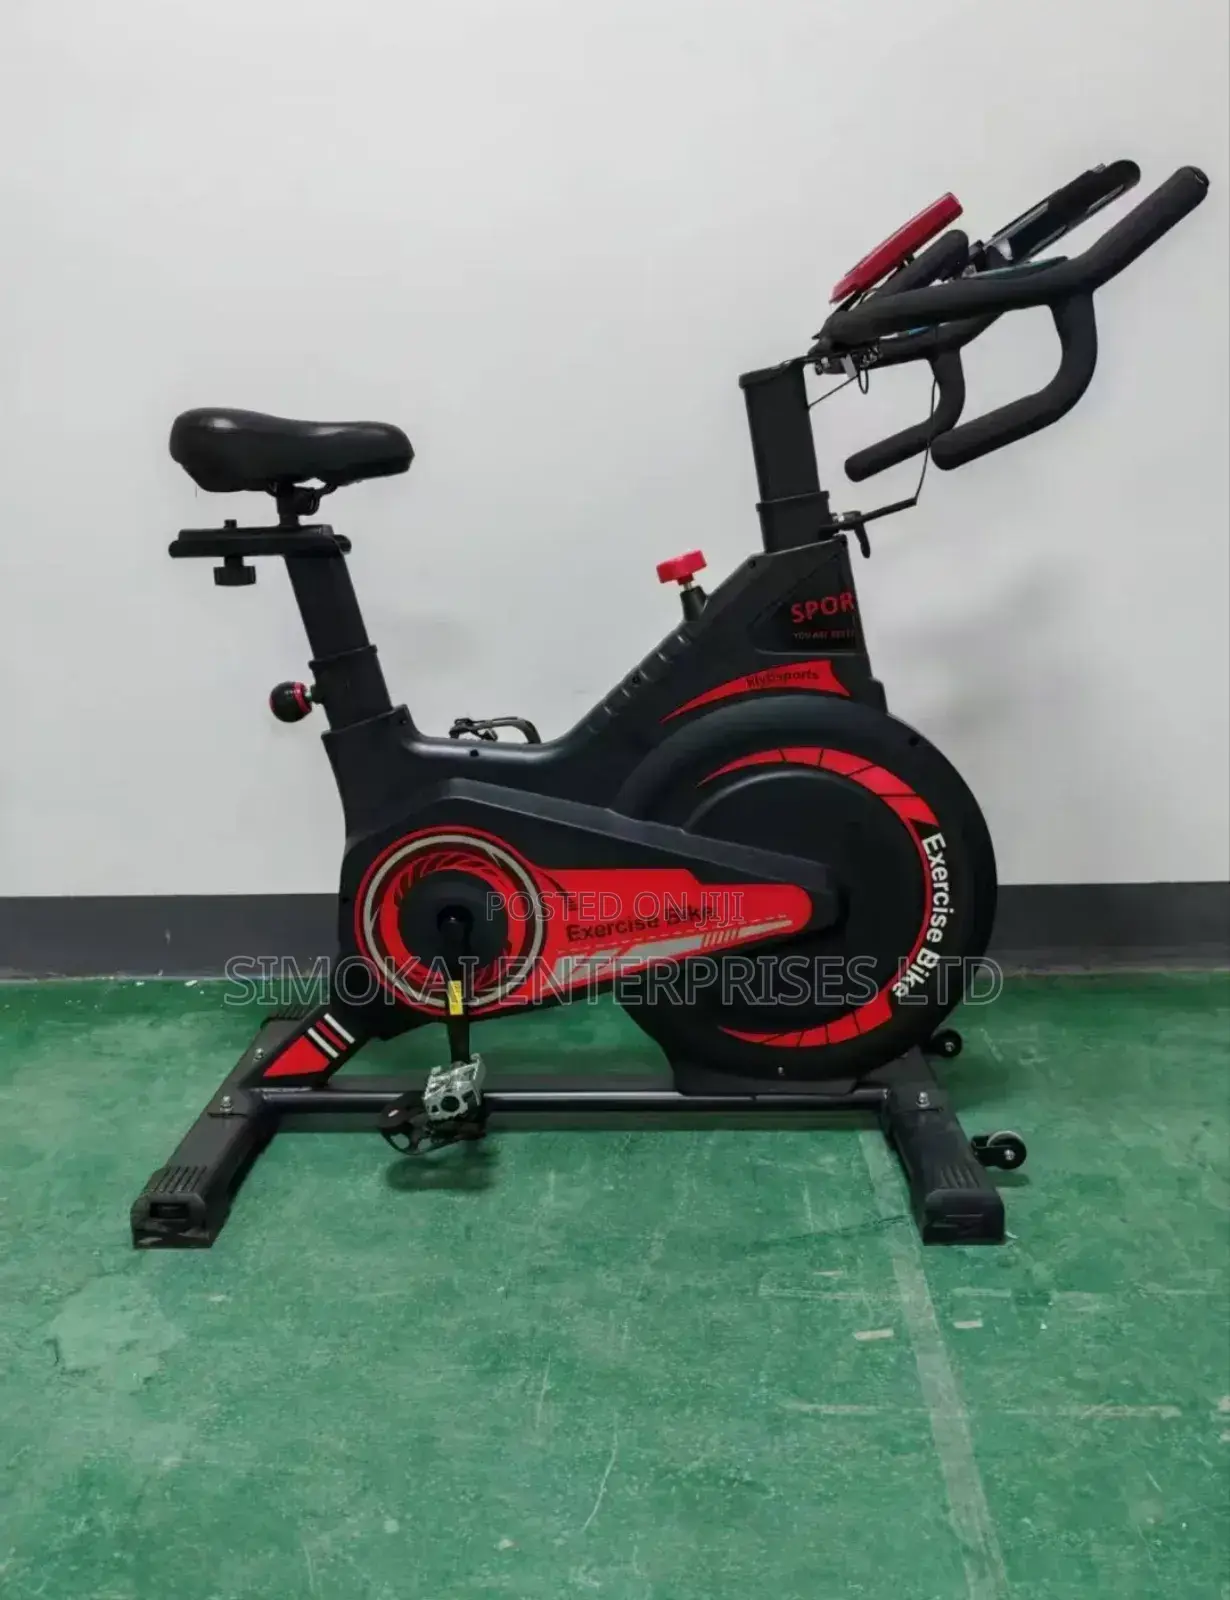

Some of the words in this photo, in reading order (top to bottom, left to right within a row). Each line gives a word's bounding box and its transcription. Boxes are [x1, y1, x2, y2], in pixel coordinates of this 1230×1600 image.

[922, 832, 954, 943] Exercise
[566, 916, 660, 942] Exercise
[665, 904, 715, 925] Bike
[892, 947, 941, 997] Bike
